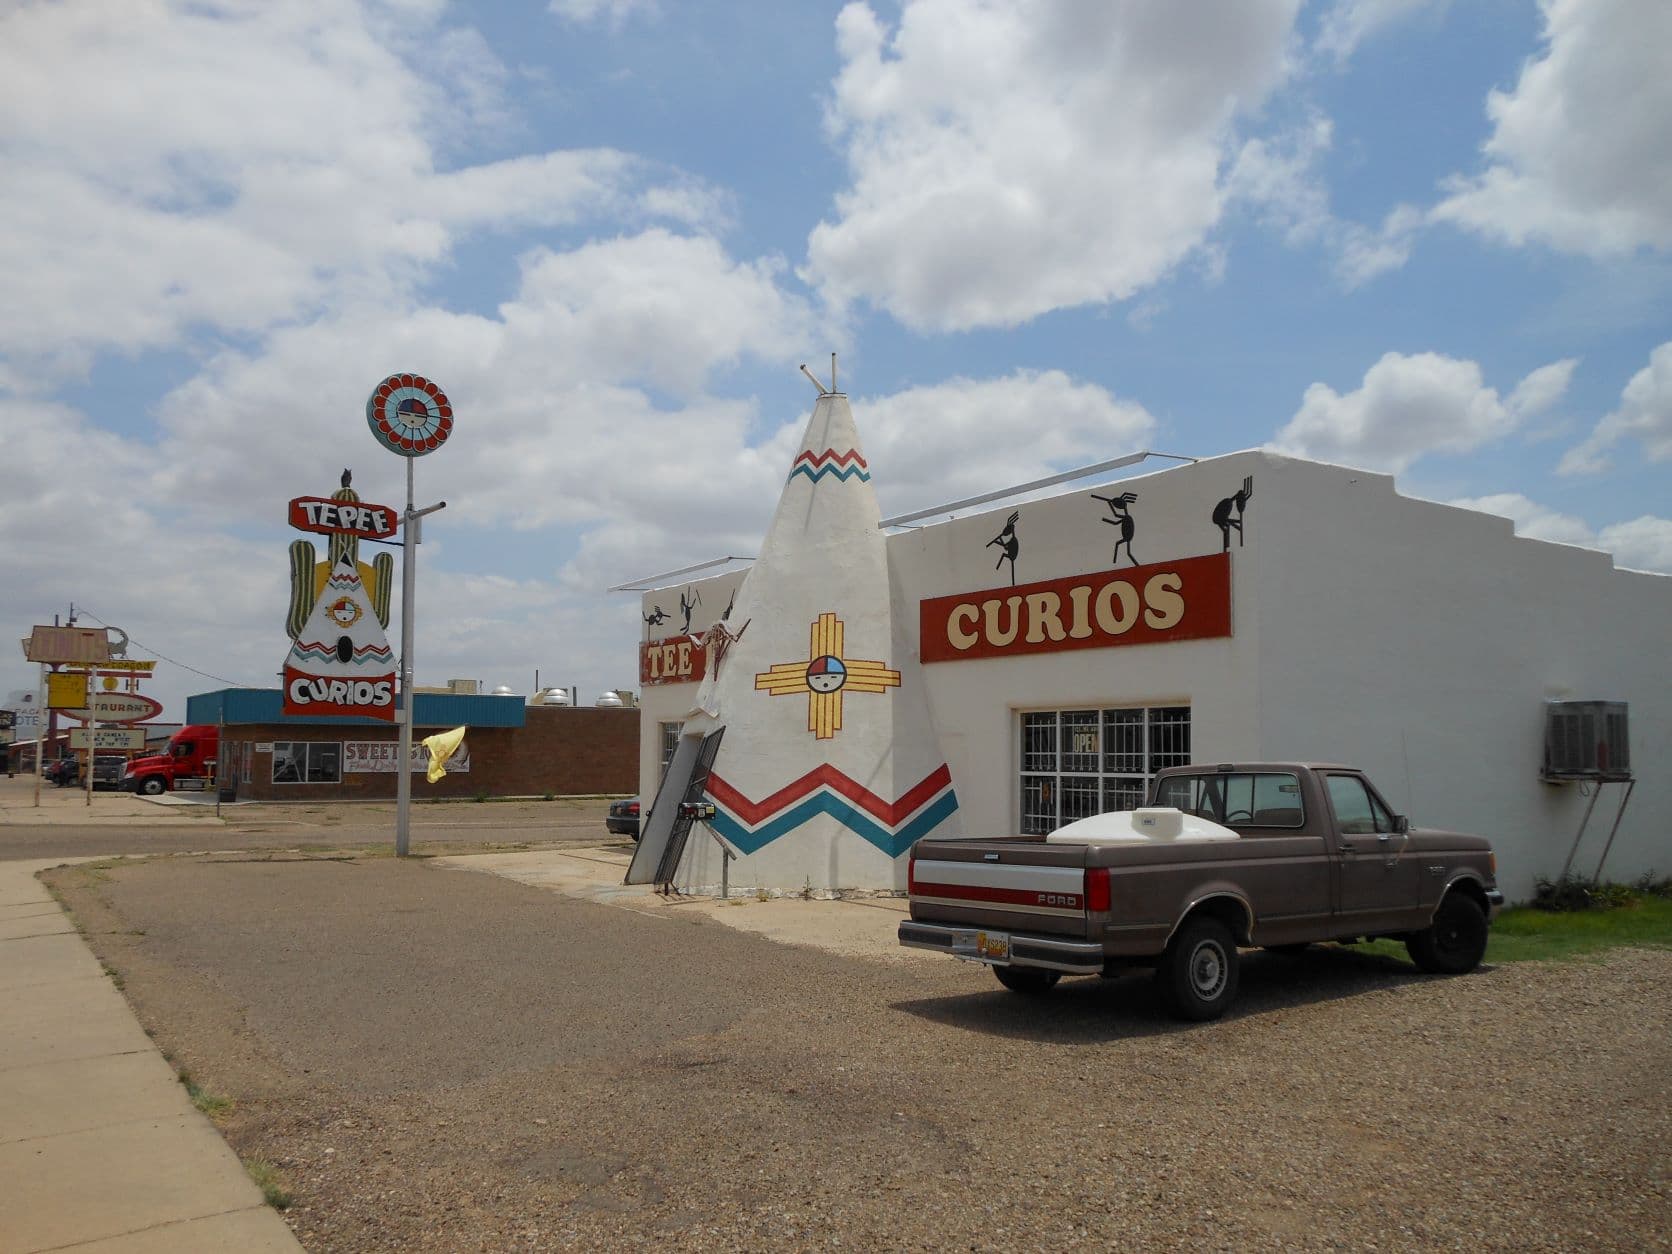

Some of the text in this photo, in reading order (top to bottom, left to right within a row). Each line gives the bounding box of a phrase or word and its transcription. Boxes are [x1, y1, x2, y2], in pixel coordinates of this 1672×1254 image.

[298, 501, 390, 534] TEPEE
[947, 572, 1185, 650] CURIOS
[647, 642, 693, 678] TEE
[289, 678, 393, 706] CURIOS
[16, 715, 47, 726] OTE
[346, 743, 397, 760] SWEET
[1074, 733, 1099, 753] OPEN
[1037, 894, 1077, 906] FORD
